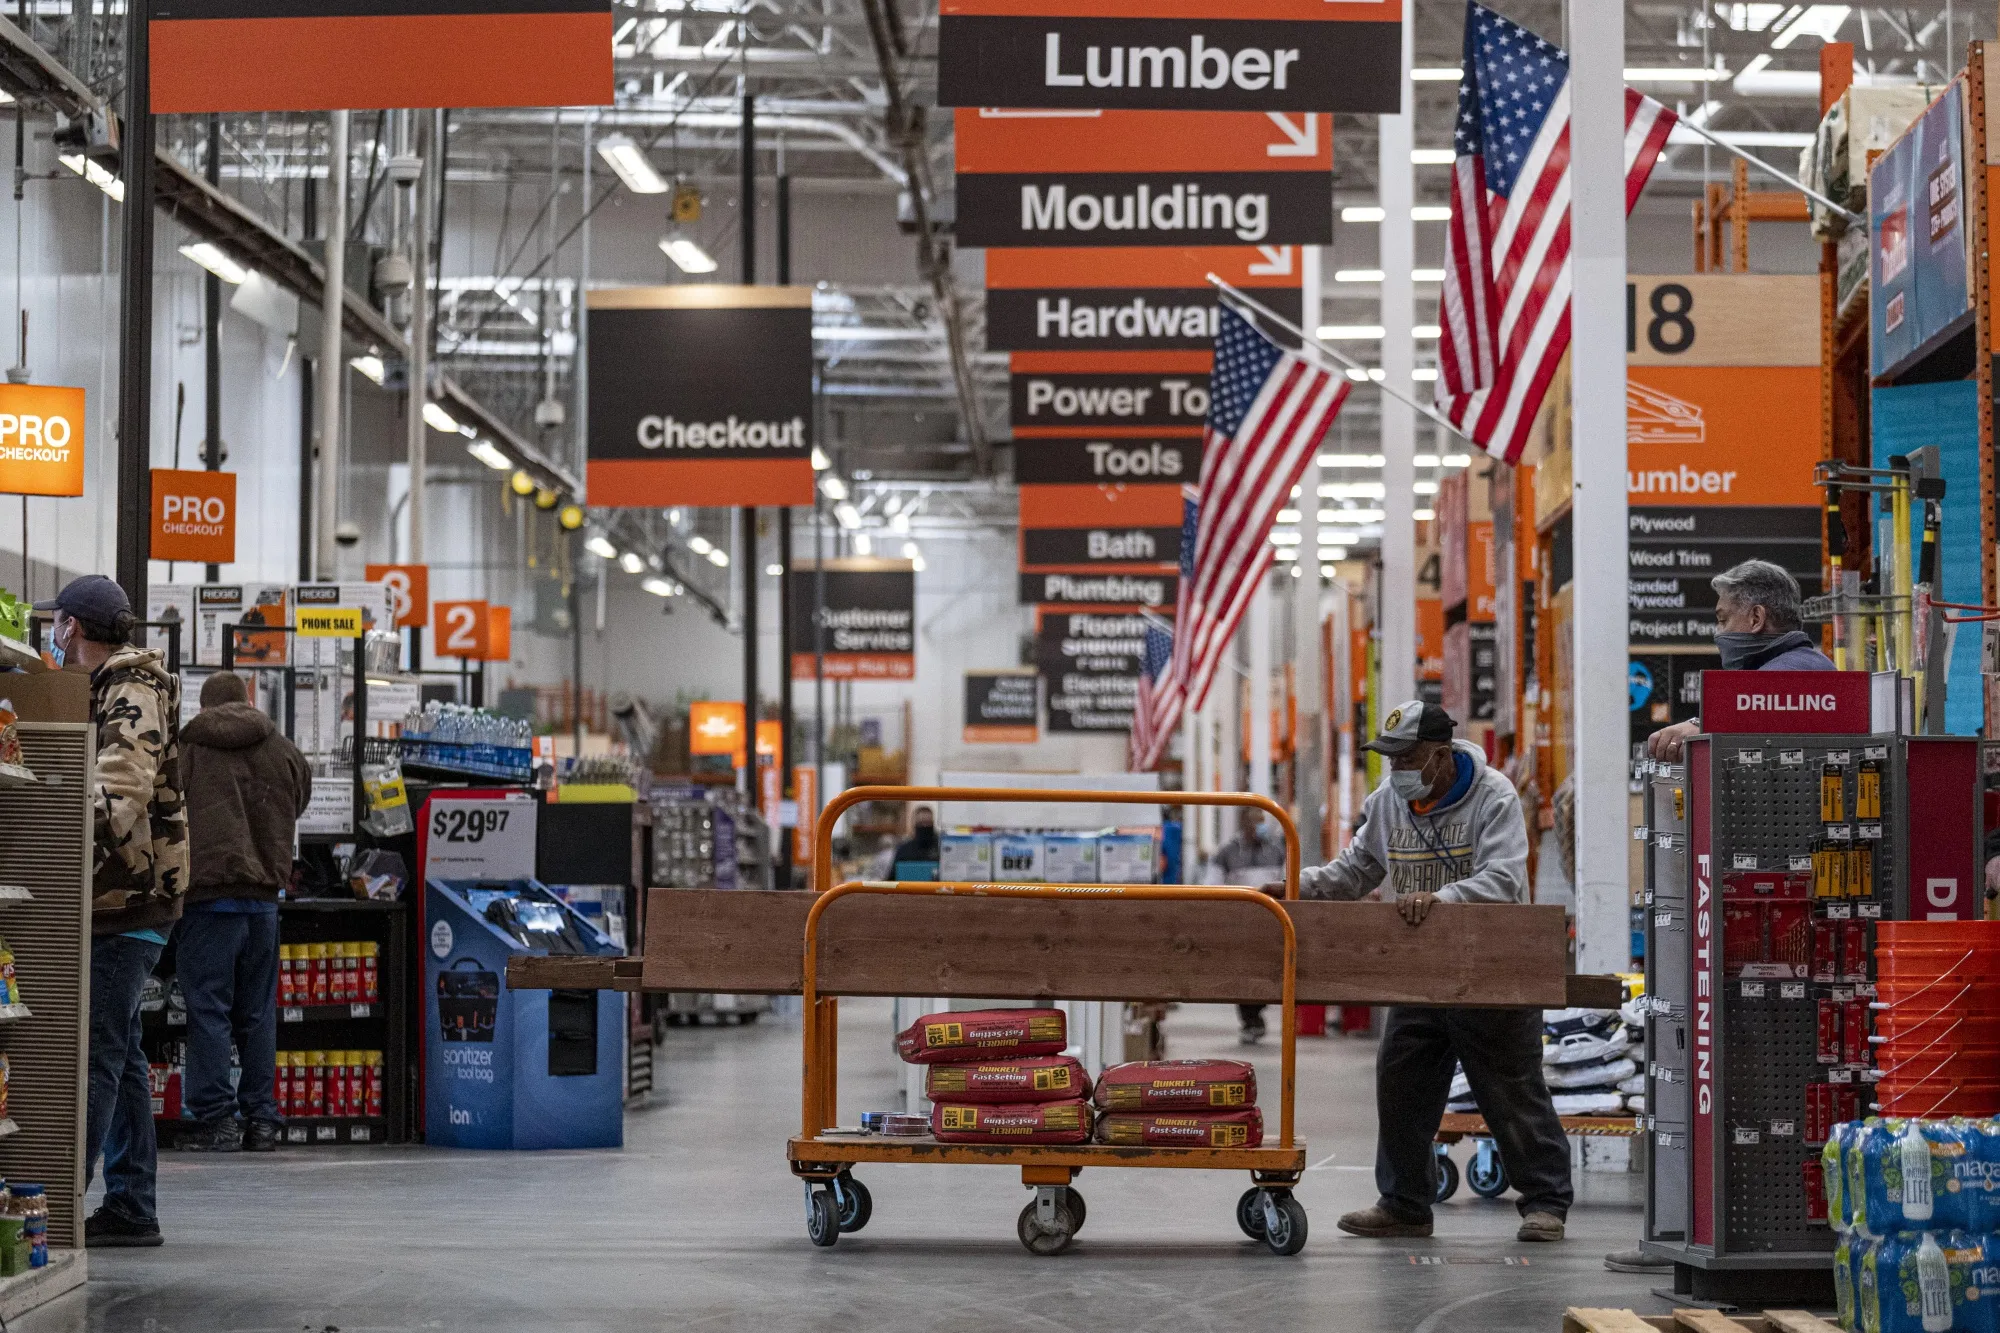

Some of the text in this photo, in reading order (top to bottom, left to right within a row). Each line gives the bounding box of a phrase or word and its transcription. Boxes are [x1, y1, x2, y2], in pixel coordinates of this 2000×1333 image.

[1045, 32, 1300, 90] Lumber
[1020, 183, 1270, 242] Moulding
[1026, 379, 1211, 417] Power To
[0, 414, 71, 447] PRO
[637, 415, 806, 449] Checkout
[0, 447, 70, 463] CHECKOUT
[1085, 441, 1184, 477] Tools
[1628, 465, 1736, 494] umber
[163, 495, 225, 524] PRO
[163, 523, 225, 536] CHECKOUT
[1629, 515, 1696, 533] Plywood
[1087, 531, 1156, 559] Bath
[1629, 550, 1712, 567] Wood Trim
[1044, 575, 1166, 607] Plumbing
[301, 618, 355, 630] PHONE SALE
[447, 605, 477, 650] 2
[1069, 614, 1148, 638] Floorin
[1630, 619, 1684, 638] Project
[1736, 694, 1837, 712] DRILLING
[1697, 853, 1711, 1116] FASTENING
[929, 1035, 944, 1044] 50
[969, 1029, 1024, 1039] Fast-Setting
[976, 1039, 1019, 1048] QUIKRETE
[443, 1048, 493, 1065] sanitizer
[458, 1066, 494, 1083] tool bag
[972, 1074, 1027, 1082] Fast-Setting
[1052, 1069, 1067, 1078] 50
[1147, 1088, 1203, 1097] Fast-Setting
[1152, 1080, 1196, 1088] QUIKRETE
[1229, 1086, 1243, 1094] 50
[944, 1118, 958, 1126] 50
[983, 1117, 1038, 1126] Fast-Setting
[1155, 1118, 1199, 1126] QUIKRETE
[990, 1127, 1034, 1135] QUIKRETE
[1149, 1127, 1204, 1136] Fast-Setting
[1231, 1128, 1245, 1136] 50
[1906, 1180, 1930, 1205] LIFE
[1971, 1266, 2000, 1286] nia
[1925, 1291, 1948, 1317] LIFE
